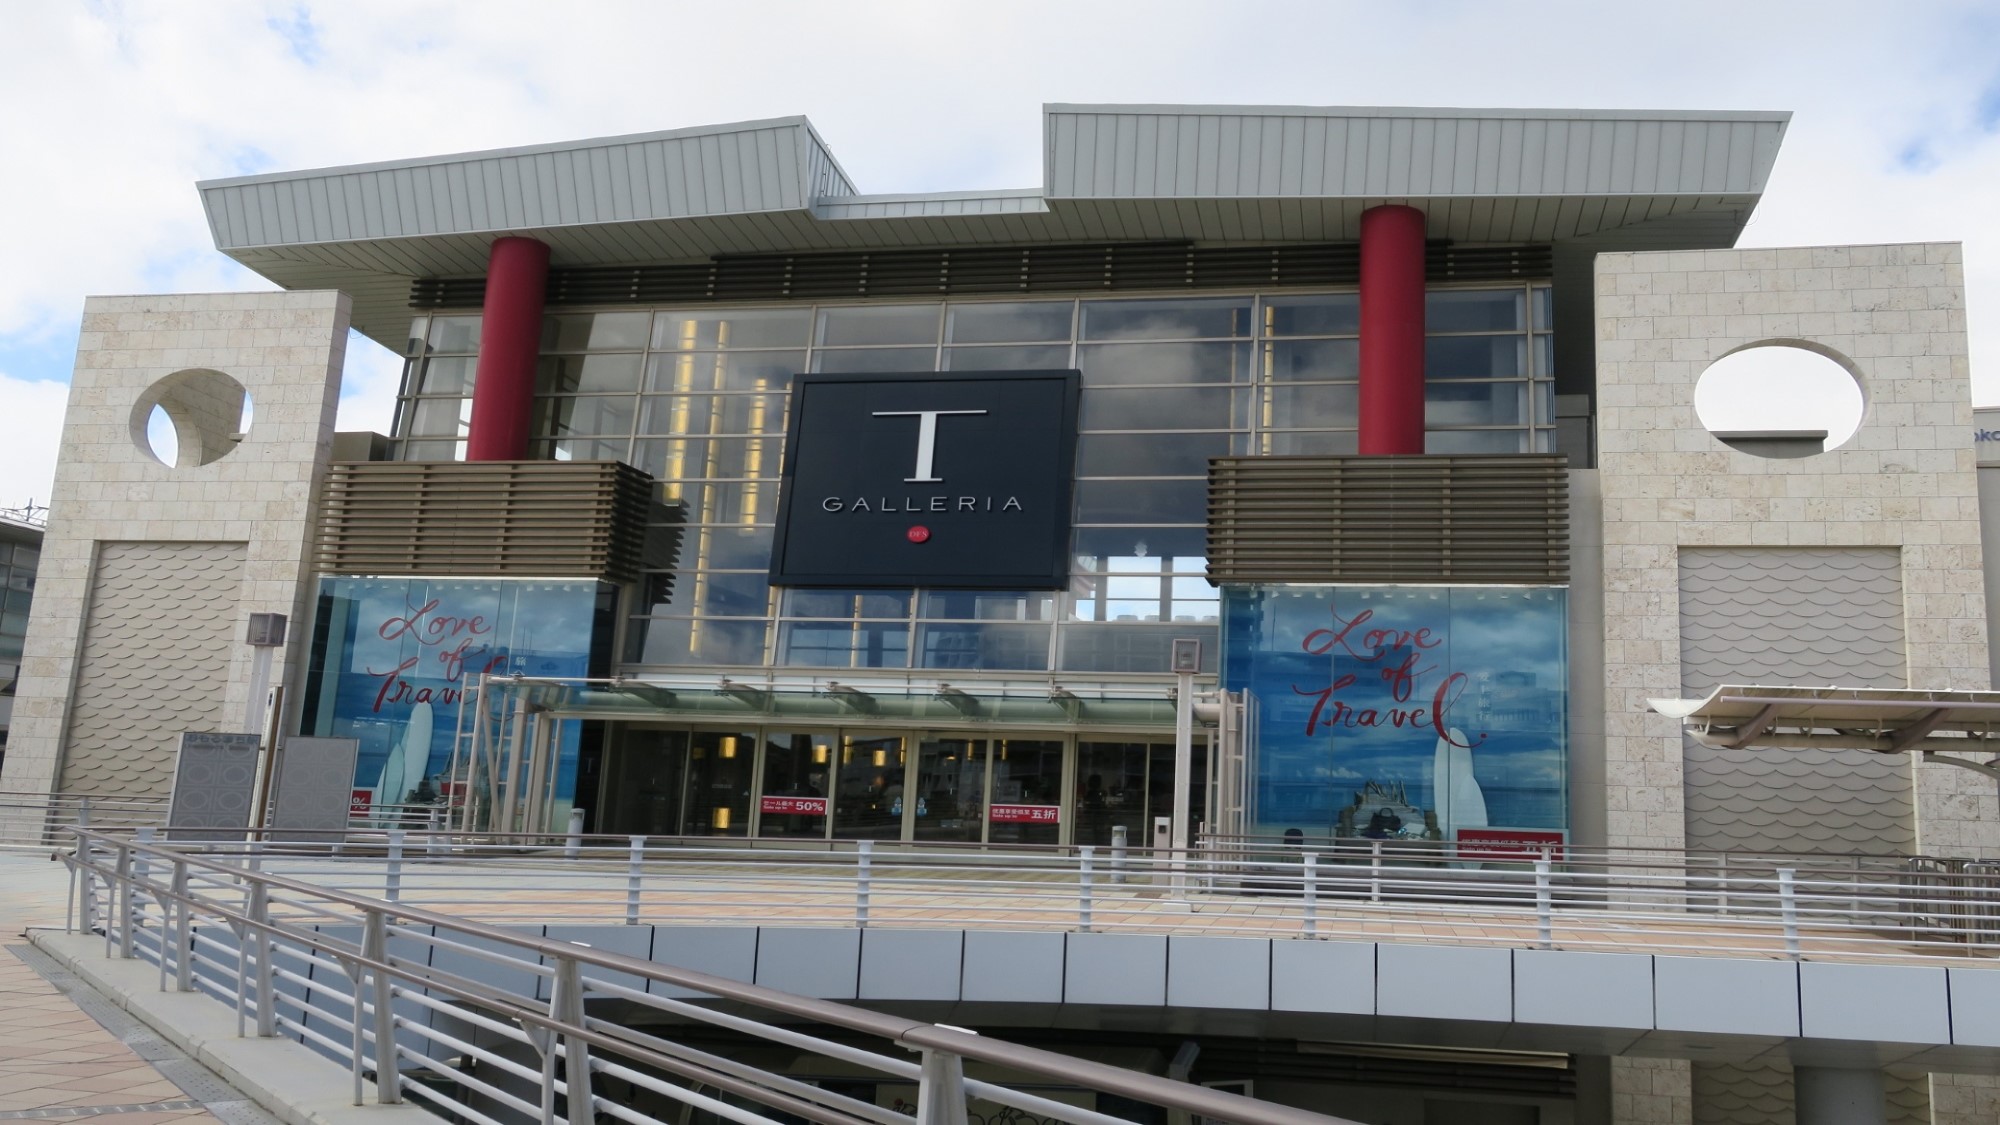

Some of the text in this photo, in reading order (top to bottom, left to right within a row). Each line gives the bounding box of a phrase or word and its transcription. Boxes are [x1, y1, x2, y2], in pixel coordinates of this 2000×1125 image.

[872, 409, 987, 482] T
[822, 495, 1022, 512] GALLERIA
[909, 530, 928, 538] DFS
[378, 593, 491, 645] Love
[1302, 602, 1442, 661] Love
[439, 638, 485, 682] of
[1381, 652, 1438, 703] of
[795, 801, 823, 812] 50%
[1031, 809, 1056, 819] 五折
